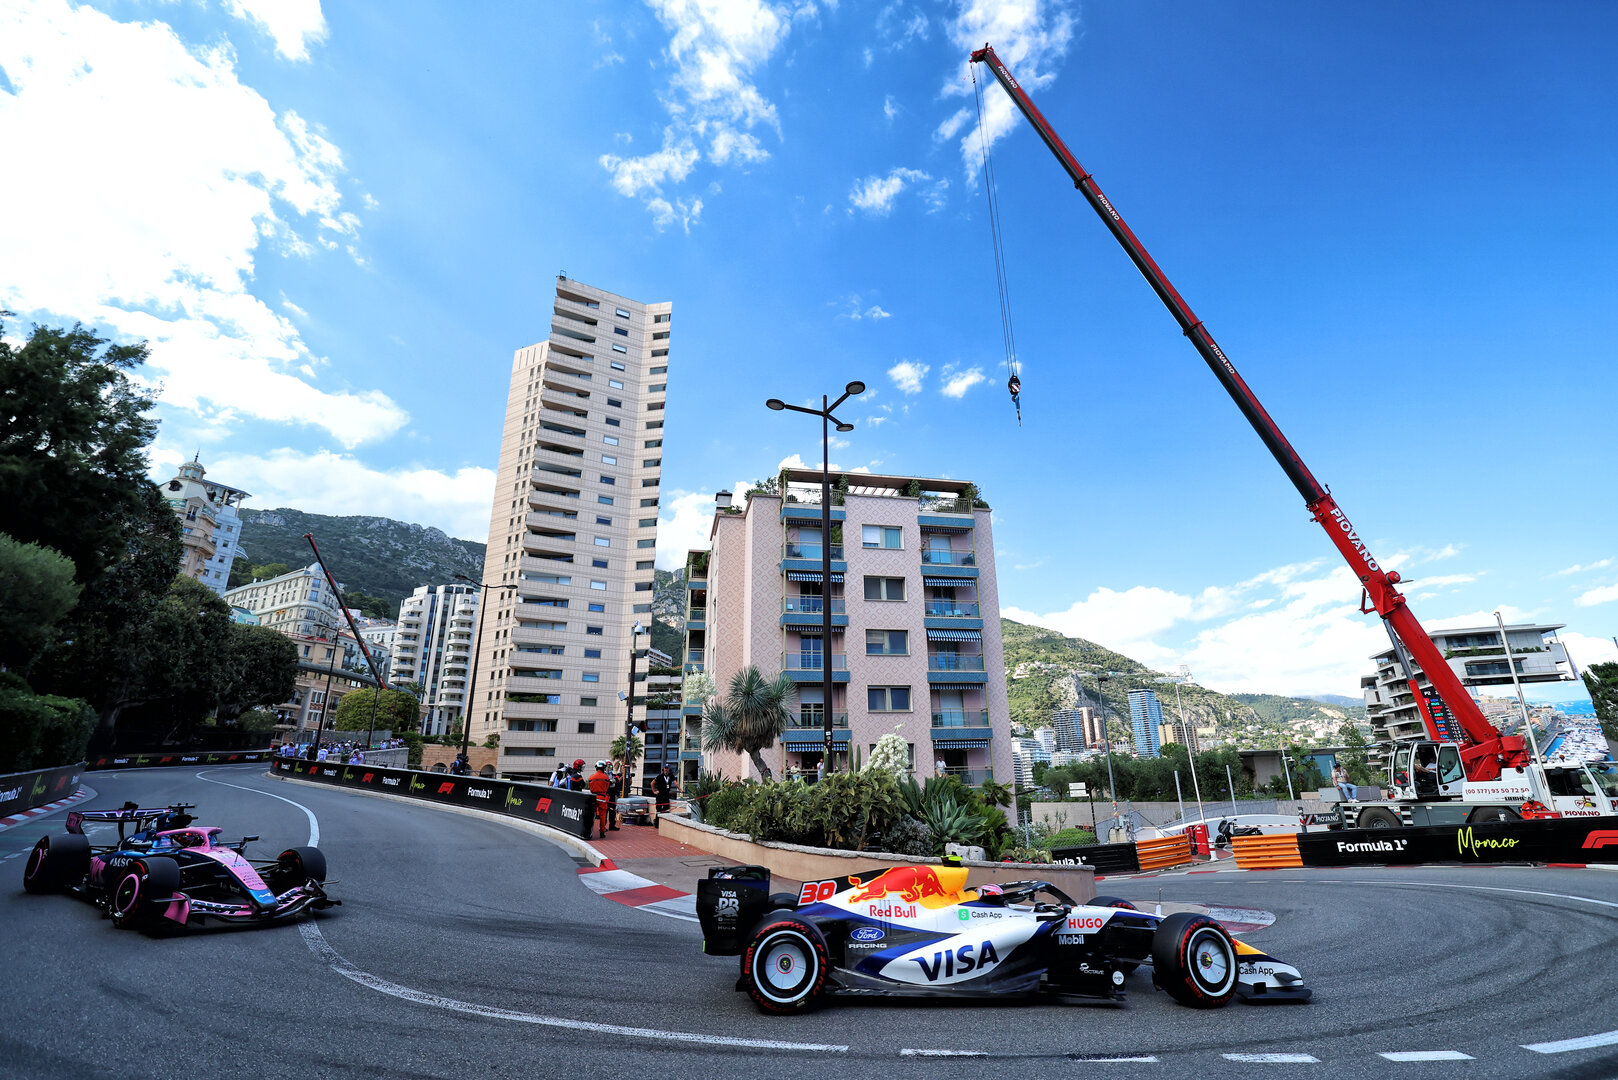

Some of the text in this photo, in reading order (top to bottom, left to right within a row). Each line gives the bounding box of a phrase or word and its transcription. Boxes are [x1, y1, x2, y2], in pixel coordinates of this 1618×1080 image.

[1097, 193, 1120, 221] PIOVANO
[1211, 343, 1235, 374] PIOVANO
[1330, 508, 1379, 572] PIOVANO
[467, 786, 487, 799] Formula
[561, 804, 577, 821] Formula
[1337, 841, 1393, 852] Formula
[1457, 826, 1520, 858] Monaco
[800, 882, 836, 904] 30
[869, 905, 917, 918] Red Bull
[971, 911, 988, 919] Cash
[989, 911, 1003, 919] App
[1068, 918, 1103, 929] HUGO
[857, 930, 878, 939] Ford
[1058, 934, 1085, 945] Mobil
[909, 940, 1000, 982] VISA
[1238, 966, 1274, 976] Cash App
